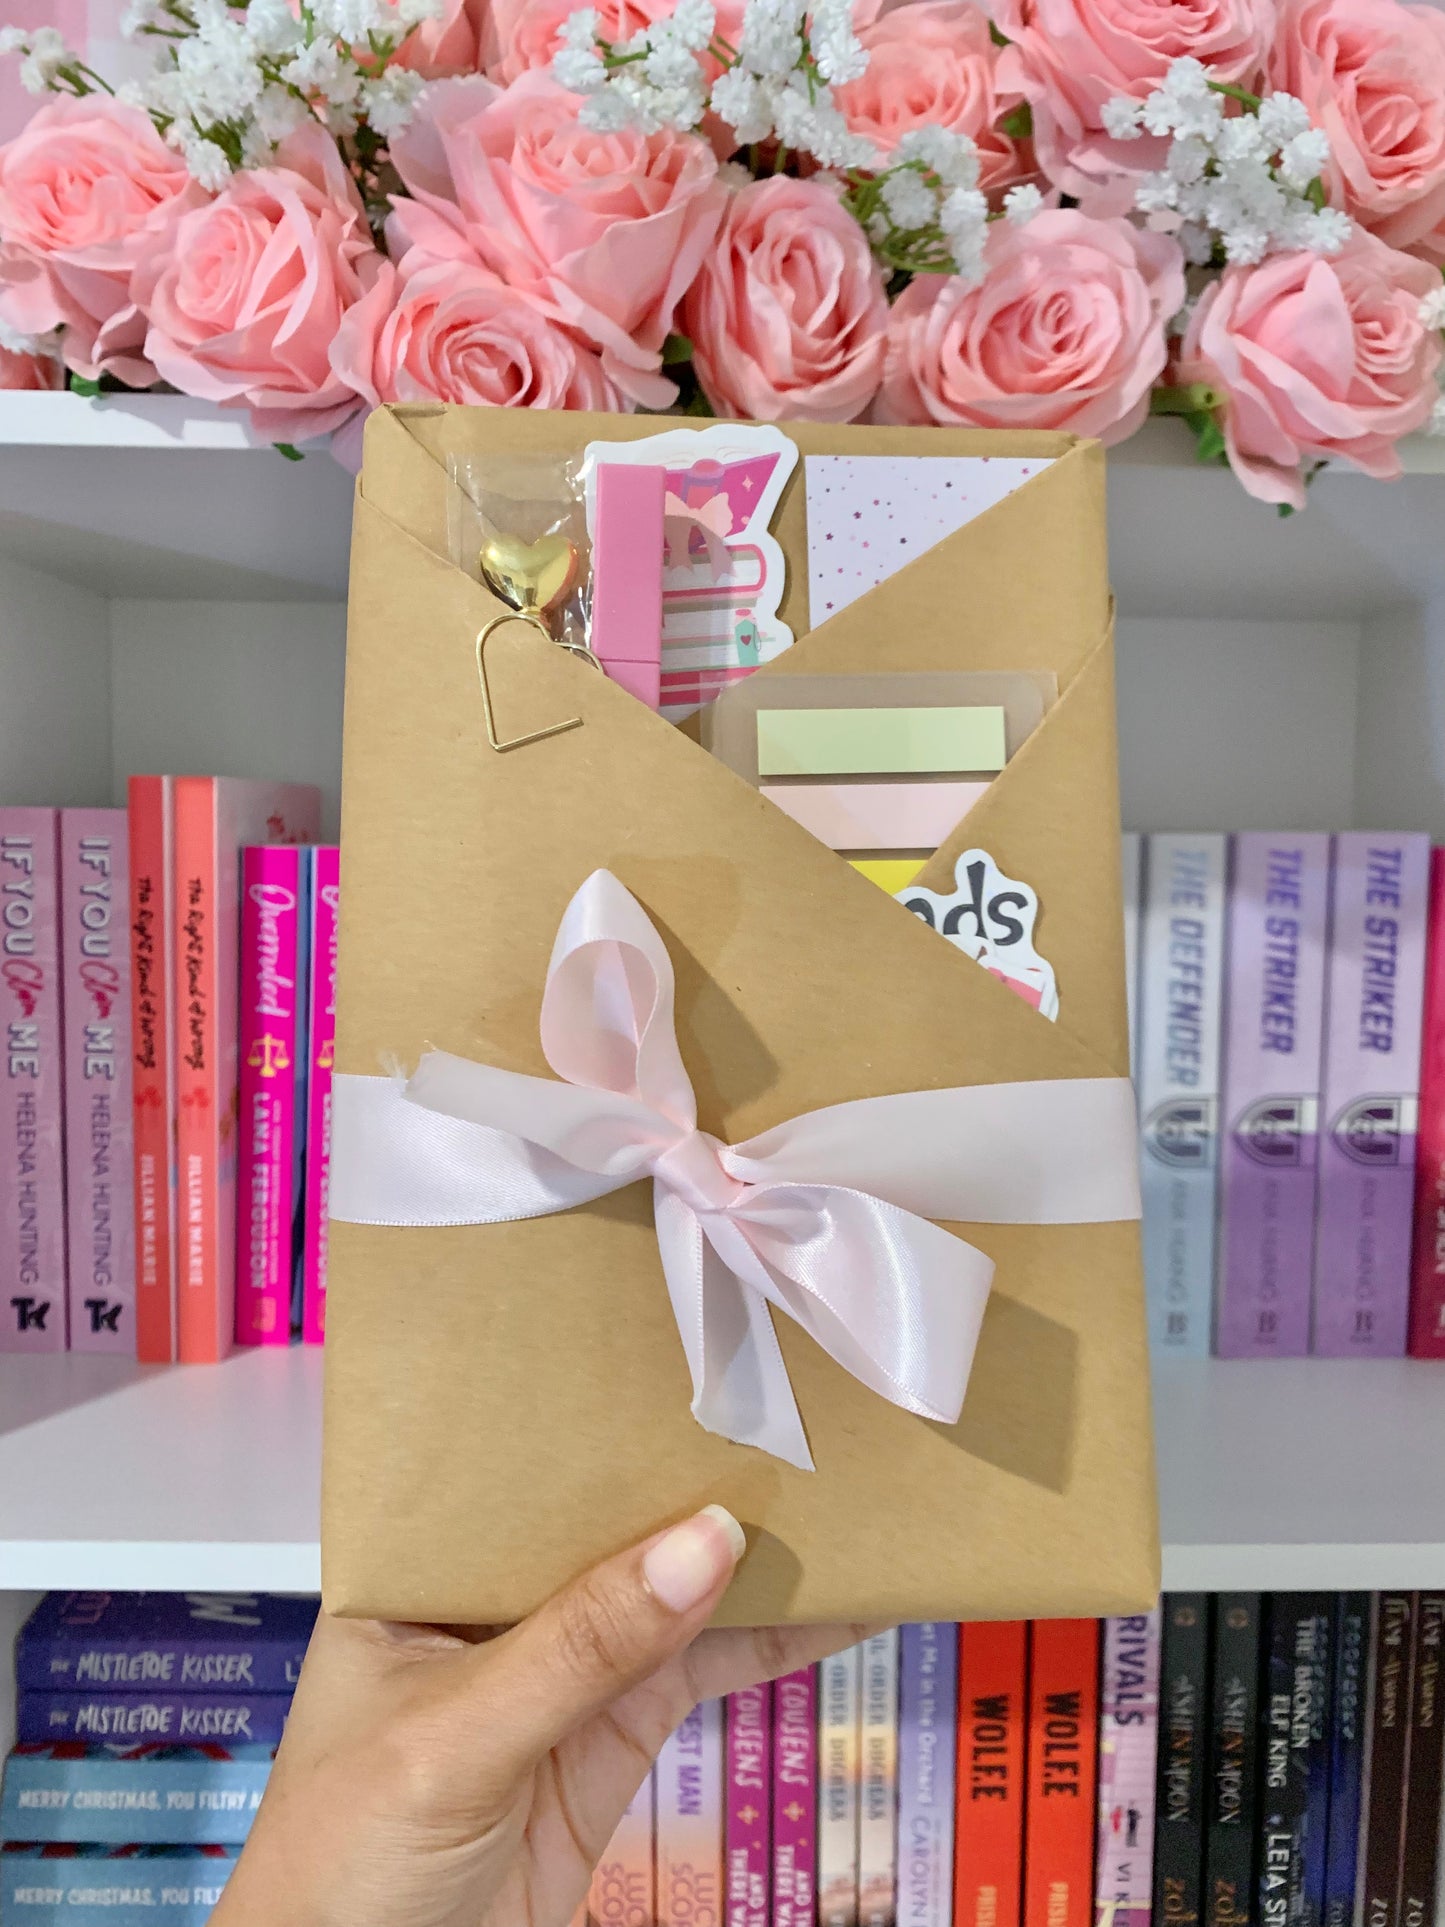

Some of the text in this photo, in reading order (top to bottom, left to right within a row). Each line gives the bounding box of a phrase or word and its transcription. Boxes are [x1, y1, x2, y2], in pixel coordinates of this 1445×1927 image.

[132, 908, 154, 953] Right
[181, 908, 203, 953] Right
[1260, 848, 1302, 1055] THE STRIKER
[1359, 848, 1402, 1055] THE STRIKER
[135, 955, 153, 997] Kind
[185, 956, 205, 998] Kind
[1166, 850, 1209, 1088] THE DEFENDER
[7, 1022, 40, 1080] ME
[83, 1024, 115, 1081] ME
[251, 1092, 270, 1155] LANA
[16, 1092, 39, 1285] HELENA HUNTING
[90, 1094, 113, 1286] HELENA HUNTING
[187, 1154, 203, 1287] JILLIAN MARIE
[249, 1163, 269, 1290] FERGUSON
[142, 1227, 157, 1286] MARIE
[75, 1651, 173, 1682] MISTLETOE
[181, 1653, 254, 1685] KISSER
[284, 1659, 303, 1682] L
[919, 1646, 935, 1673] Me
[1114, 1616, 1148, 1726] RIVALS
[869, 1664, 886, 1726] ORDER
[920, 1678, 934, 1694] in
[75, 1705, 171, 1734] MISTLETOE
[180, 1707, 253, 1739] KISSER
[735, 1688, 763, 1789] COUSENS
[779, 1682, 809, 1786] COUSENS
[920, 1699, 935, 1727] the
[917, 1732, 936, 1803] Orchard
[1268, 1739, 1288, 1788] KING
[18, 1790, 70, 1808] MERRY
[73, 1790, 161, 1810] CHRISTMAS,
[167, 1791, 195, 1809] YOU
[198, 1790, 245, 1810] FILTHY
[678, 1766, 702, 1816] MAN
[730, 1849, 749, 1901] THERE
[776, 1845, 795, 1897] THERE
[910, 1815, 930, 1917] CAROLYN
[1117, 1863, 1133, 1883] VI
[1267, 1833, 1291, 1890] LEIA
[14, 1889, 64, 1904] MERRY
[68, 1888, 156, 1905] CHRISTMAS,
[161, 1888, 188, 1904] YOU
[748, 1873, 765, 1909] AND
[795, 1870, 812, 1906] AND
